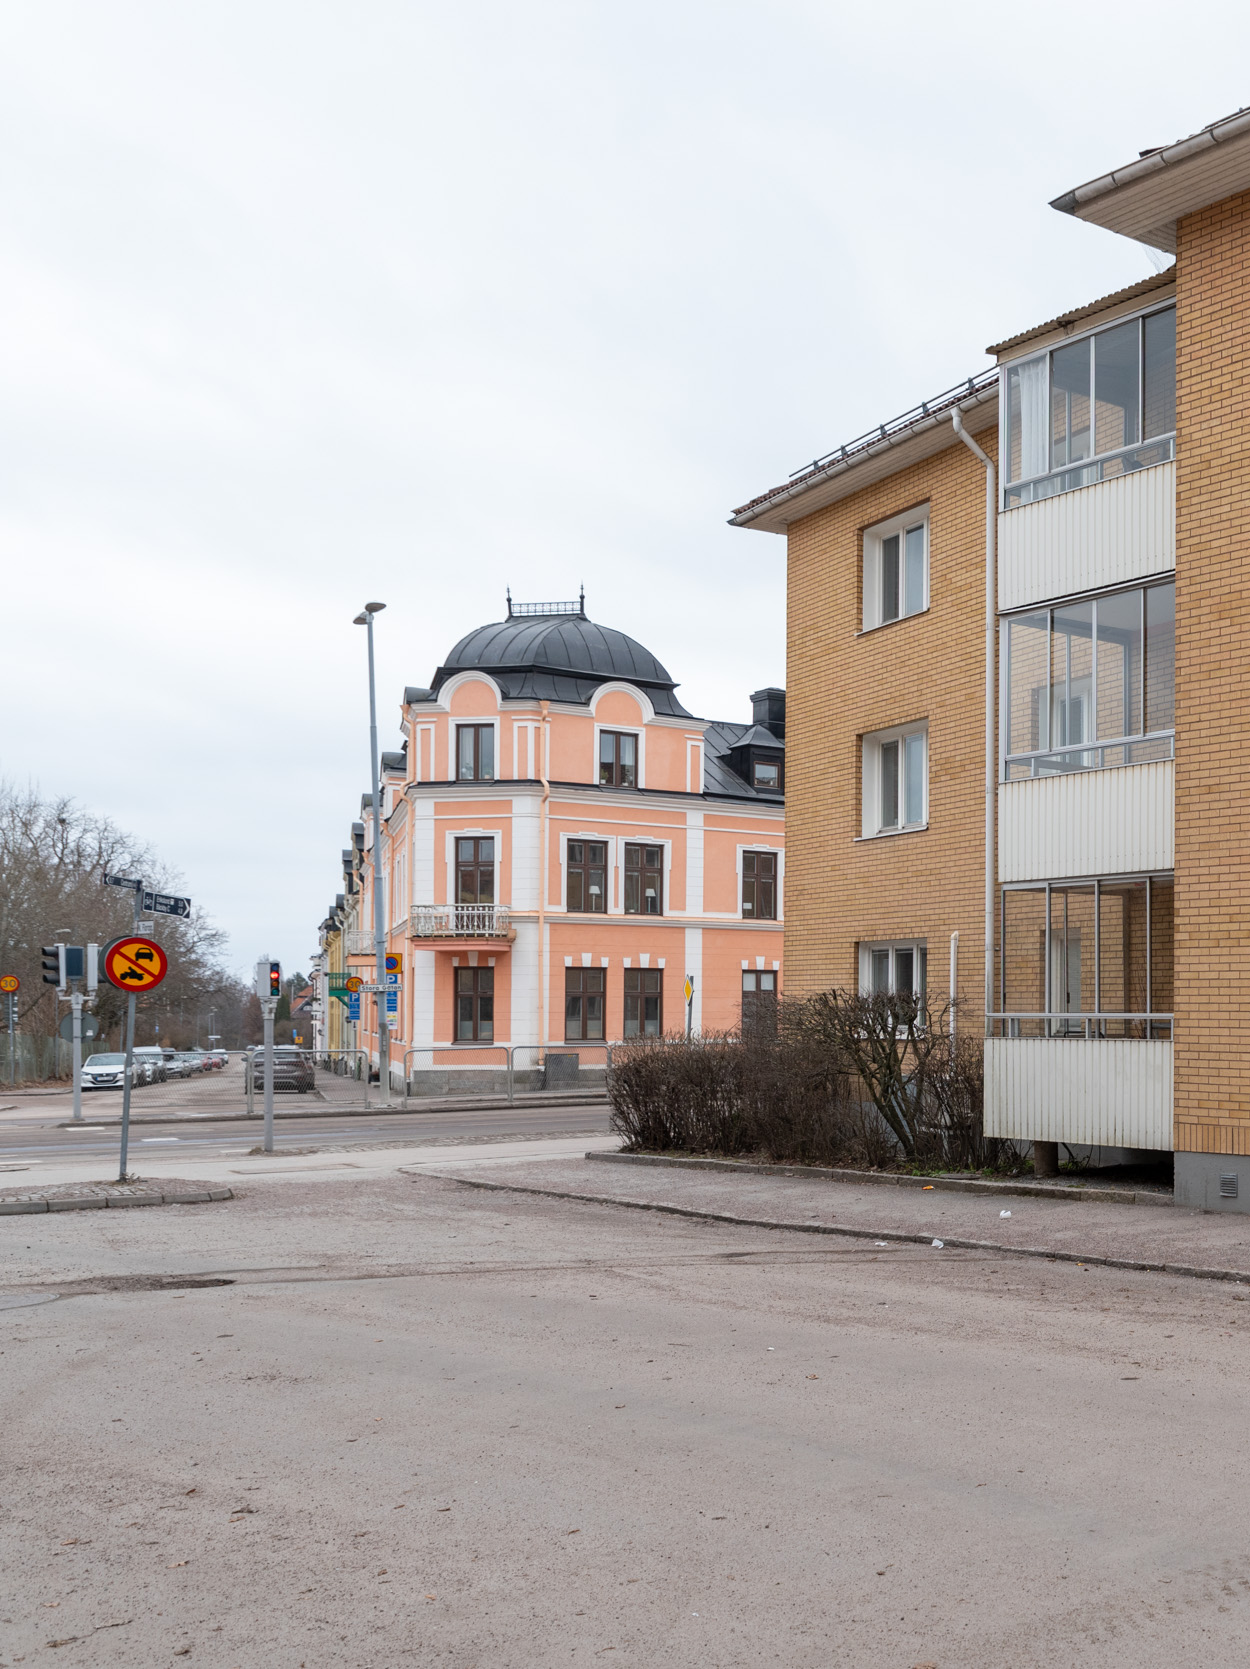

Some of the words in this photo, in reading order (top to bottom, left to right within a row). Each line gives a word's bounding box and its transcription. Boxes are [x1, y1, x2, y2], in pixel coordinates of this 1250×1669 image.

[2, 979, 17, 988] 30
[386, 975, 395, 984] P
[349, 980, 361, 989] 30
[351, 993, 359, 1002] P
